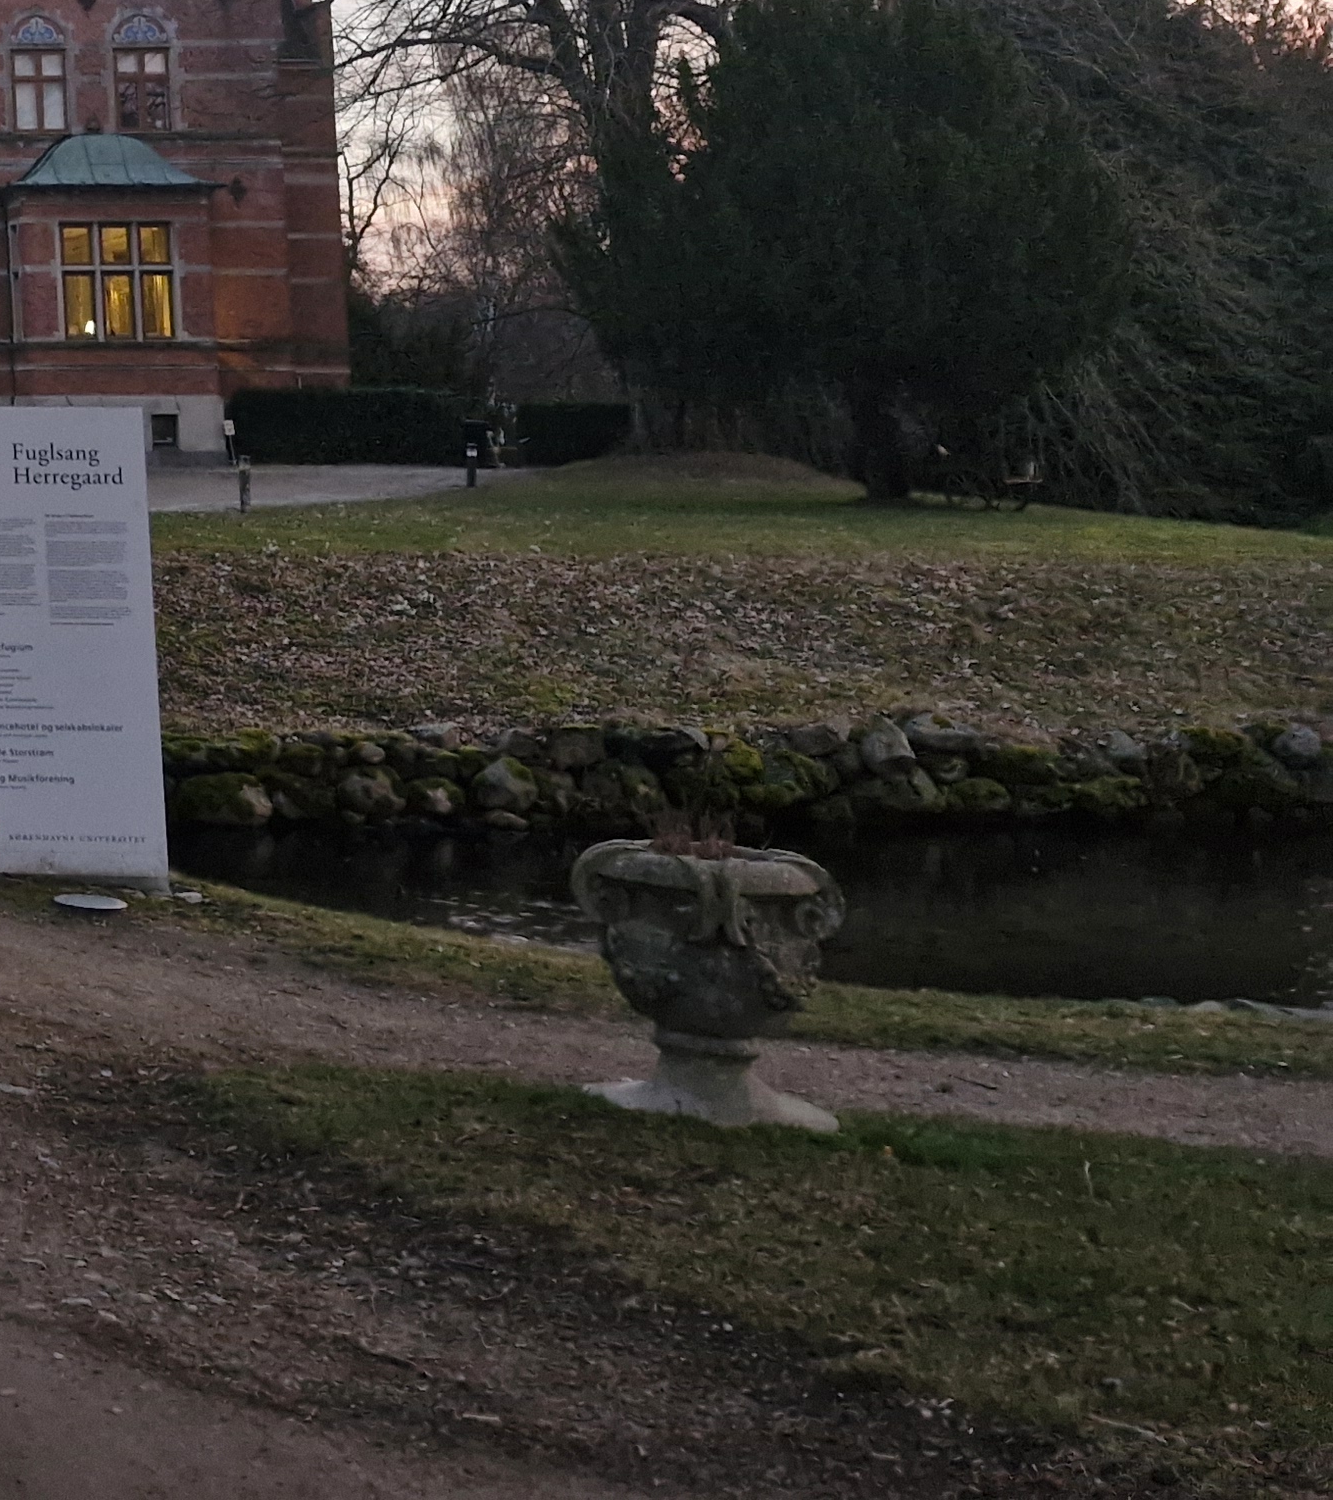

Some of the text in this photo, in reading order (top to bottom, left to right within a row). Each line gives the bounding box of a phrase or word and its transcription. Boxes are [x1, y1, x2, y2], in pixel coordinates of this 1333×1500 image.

[12, 442, 100, 467] Fuglsang
[13, 466, 124, 491] Herregaard
[41, 723, 54, 732] og
[8, 774, 75, 785] Musikforening
